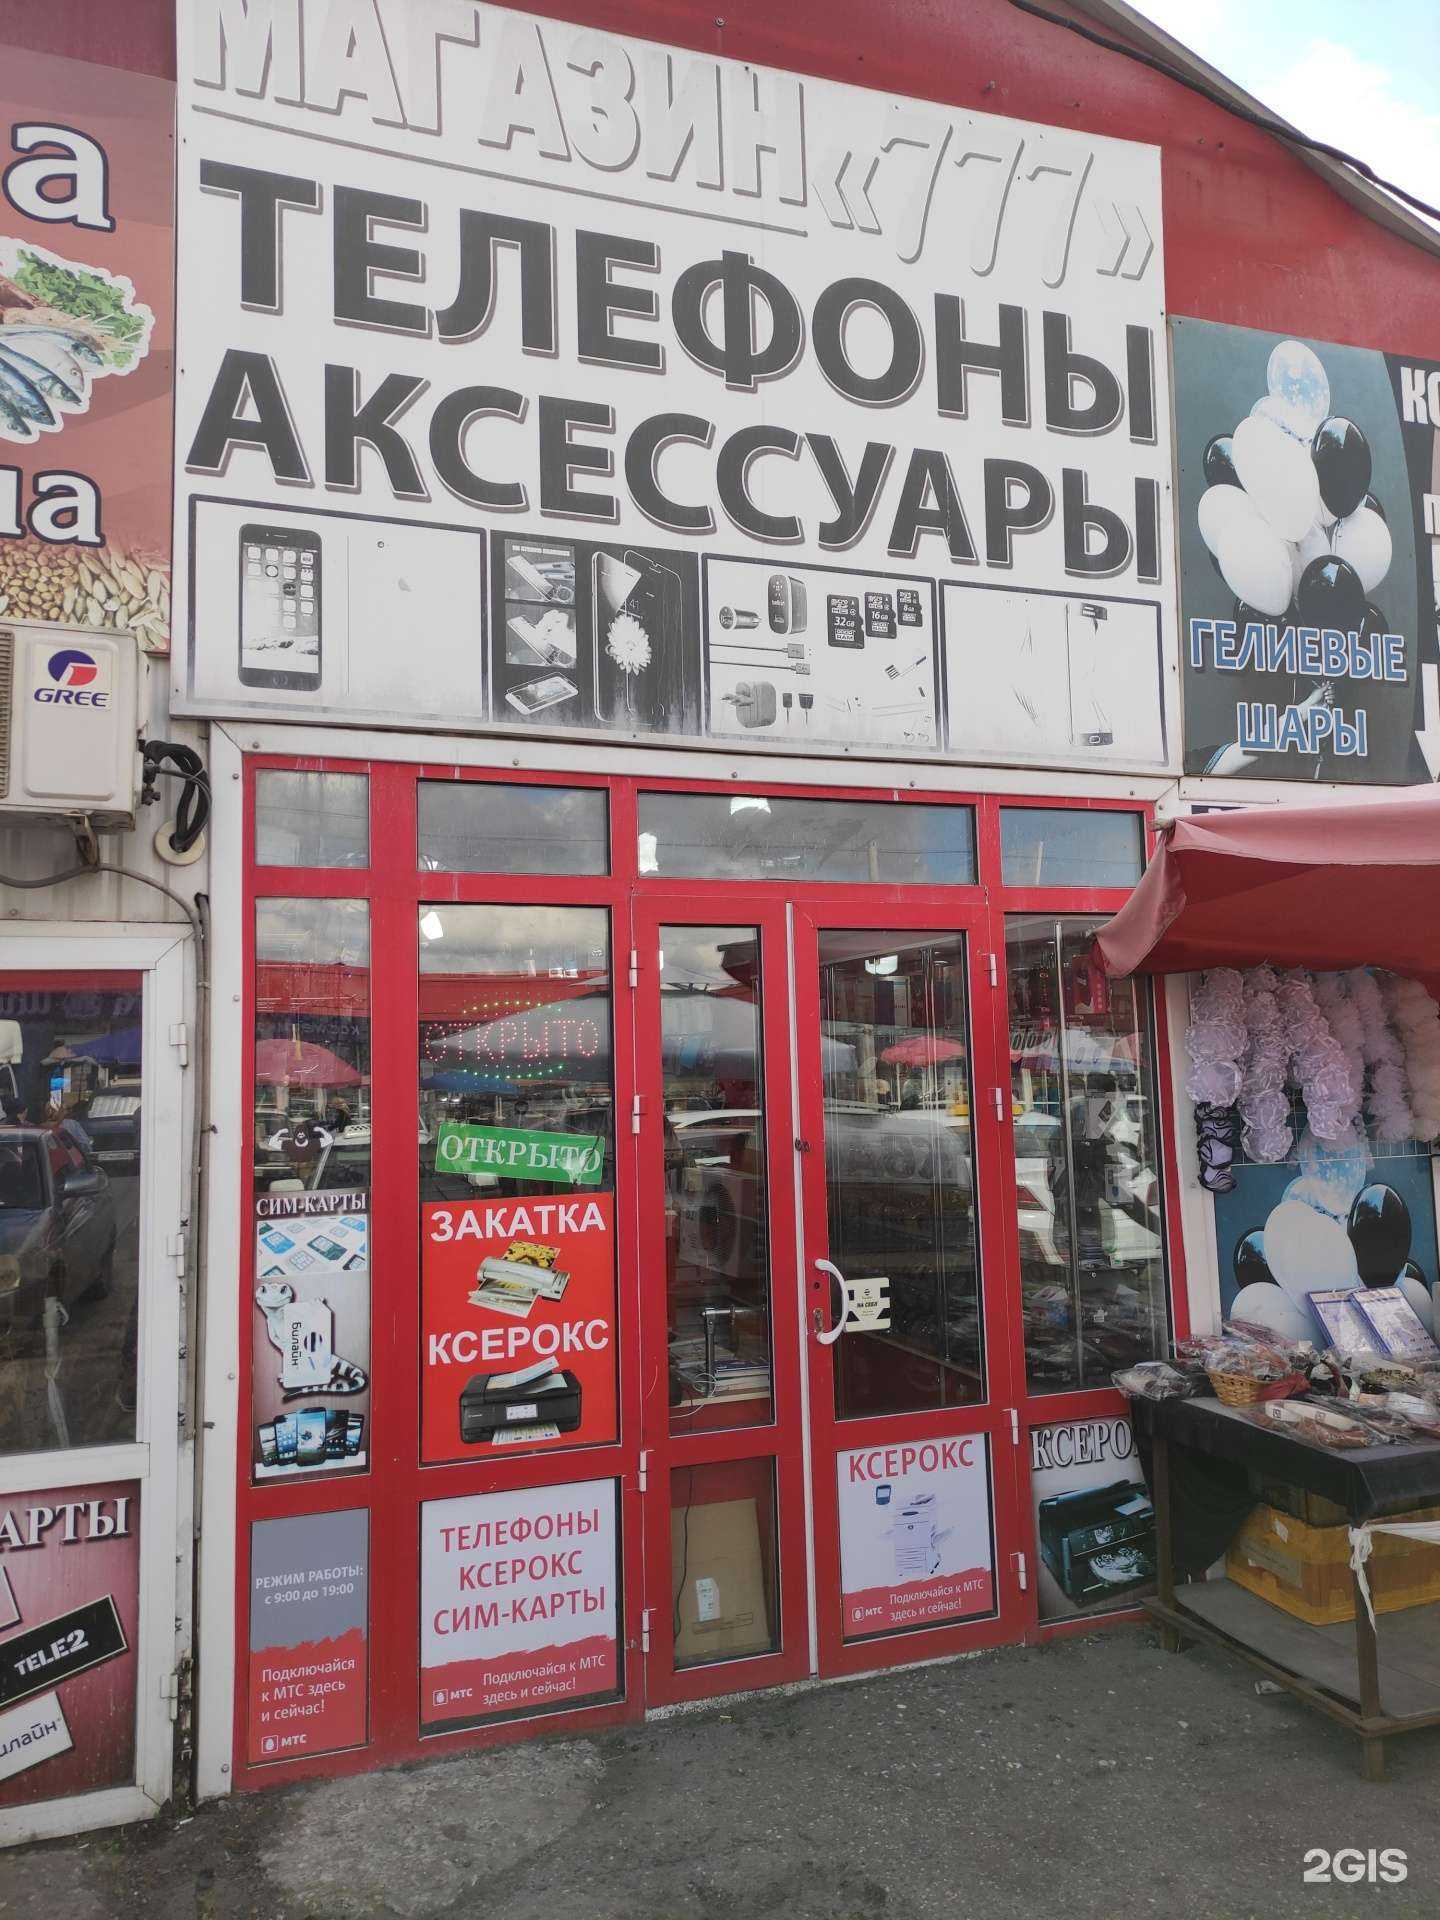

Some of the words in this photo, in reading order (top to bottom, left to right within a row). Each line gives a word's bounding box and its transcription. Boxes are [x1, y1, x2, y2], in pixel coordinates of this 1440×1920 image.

[194, 0, 807, 207] МАГАЗИН
[200, 158, 1158, 445] ТЕЛЕФОНЫ
[185, 348, 1161, 584] АКСЕССУАРЫ
[1189, 618, 1407, 682] ГЕЛИЕВЫЕ
[34, 687, 110, 707] GREE
[1236, 702, 1368, 757] ШАРЫ
[425, 1018, 601, 1062] ОТКРЫТО
[440, 1133, 602, 1174] ОТКРЫТО
[256, 1192, 367, 1216] СИМ-КАРТЫ
[429, 1202, 606, 1243] ЗАКАТКА
[291, 1321, 302, 1366] билайн
[428, 1319, 610, 1366] КСЕРОКС
[849, 1439, 975, 1483] КСЕРОКС
[1031, 1418, 1138, 1471] КСЕРО
[439, 1508, 600, 1553] ТЕЛЕФОНЫ
[255, 1572, 305, 1589] РЕЖИМ
[308, 1565, 364, 1582] РАБОТЫ:
[458, 1549, 584, 1592] КСЕРОКС
[890, 1585, 954, 1606] Подключайся
[955, 1583, 961, 1593] к
[963, 1578, 984, 1592] МТС
[274, 1589, 300, 1604] 9:00
[302, 1588, 319, 1602] до
[322, 1582, 354, 1597] 19:00
[433, 1586, 606, 1636] СИМ-КАРТЫ
[890, 1608, 917, 1622] здесь
[919, 1606, 926, 1615] и
[927, 1598, 962, 1615] сейчас!
[14, 1628, 89, 1676] TELE2
[262, 1658, 356, 1683] Подключайся
[482, 1662, 566, 1687] Подключайся
[570, 1660, 577, 1671] к
[579, 1654, 607, 1670] МТС
[261, 1691, 270, 1702] к
[273, 1683, 305, 1701] МТС
[308, 1679, 346, 1698] здесь
[261, 1711, 270, 1723] и
[274, 1699, 326, 1721] сейчас!
[482, 1690, 518, 1706] здесь
[520, 1687, 528, 1698] и
[531, 1677, 577, 1697] сейчас!
